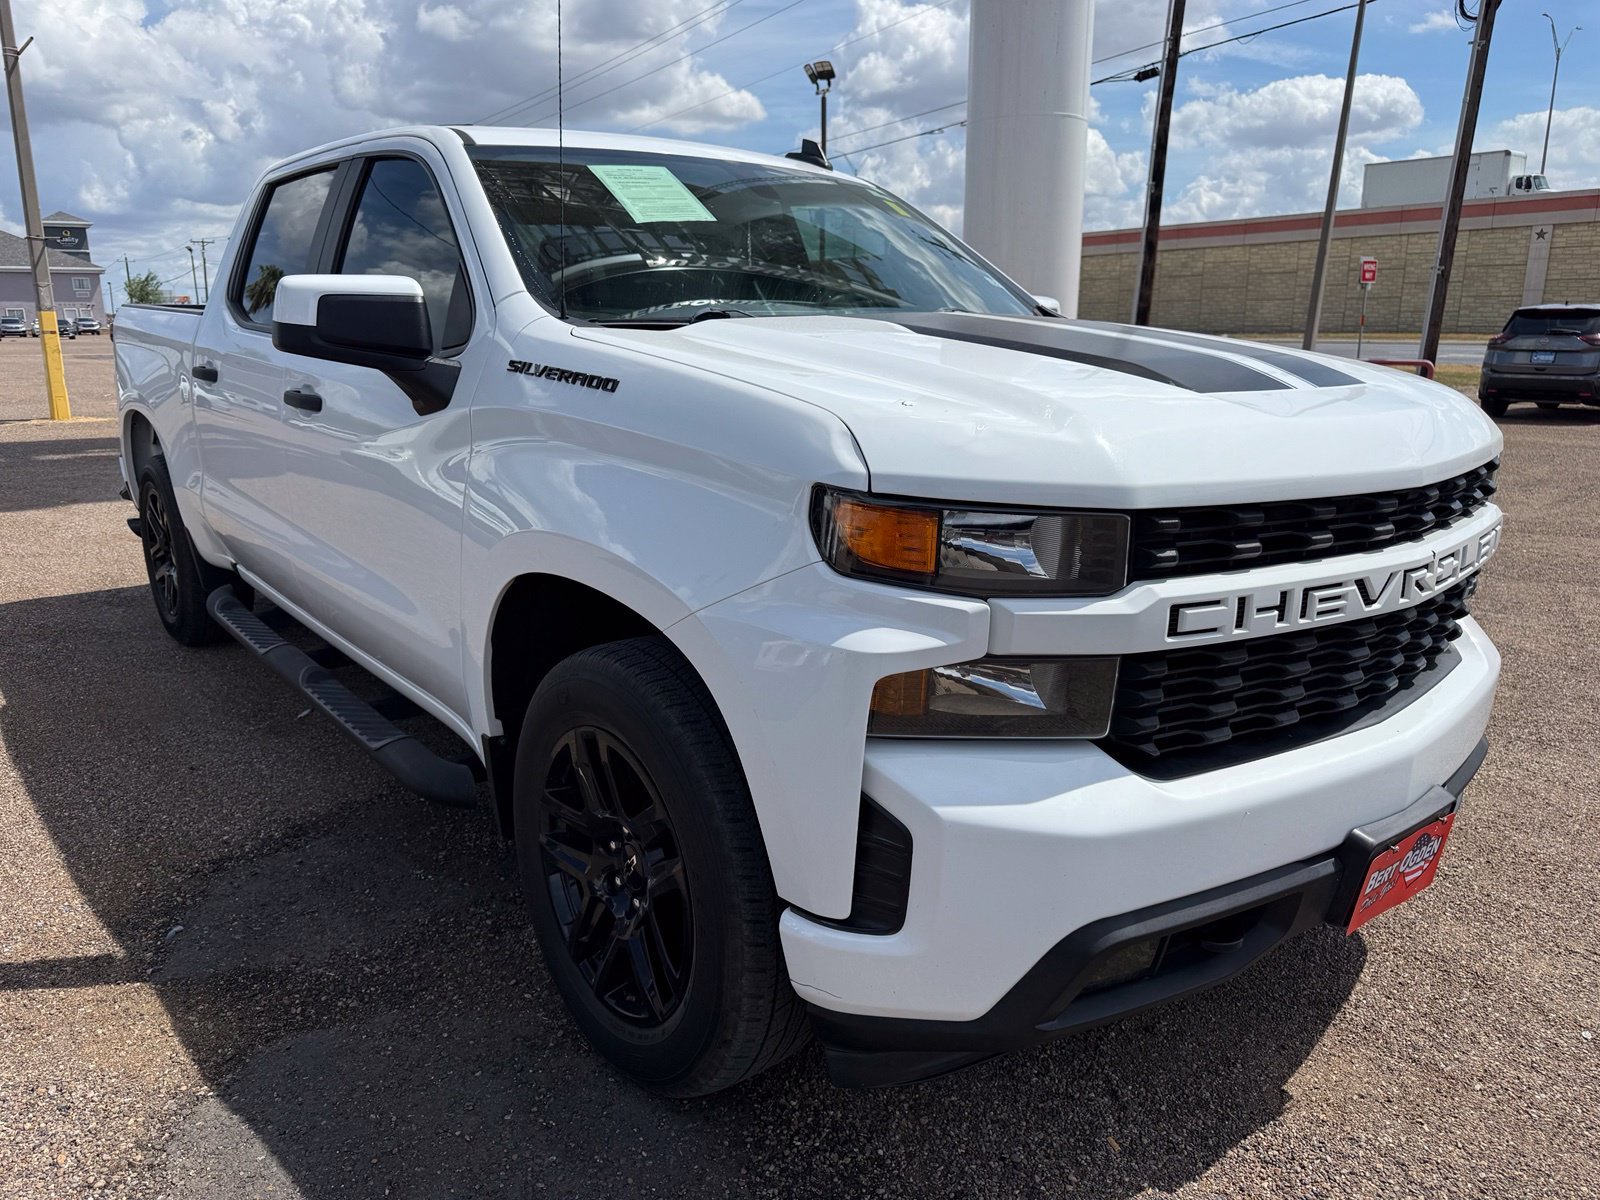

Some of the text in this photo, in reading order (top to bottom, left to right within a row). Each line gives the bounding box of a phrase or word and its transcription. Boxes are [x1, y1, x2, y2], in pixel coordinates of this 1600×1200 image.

[506, 359, 620, 393] SILVERADO
[1166, 526, 1500, 642] CHEVROLET
[1364, 836, 1442, 895] BERT OGDEN
